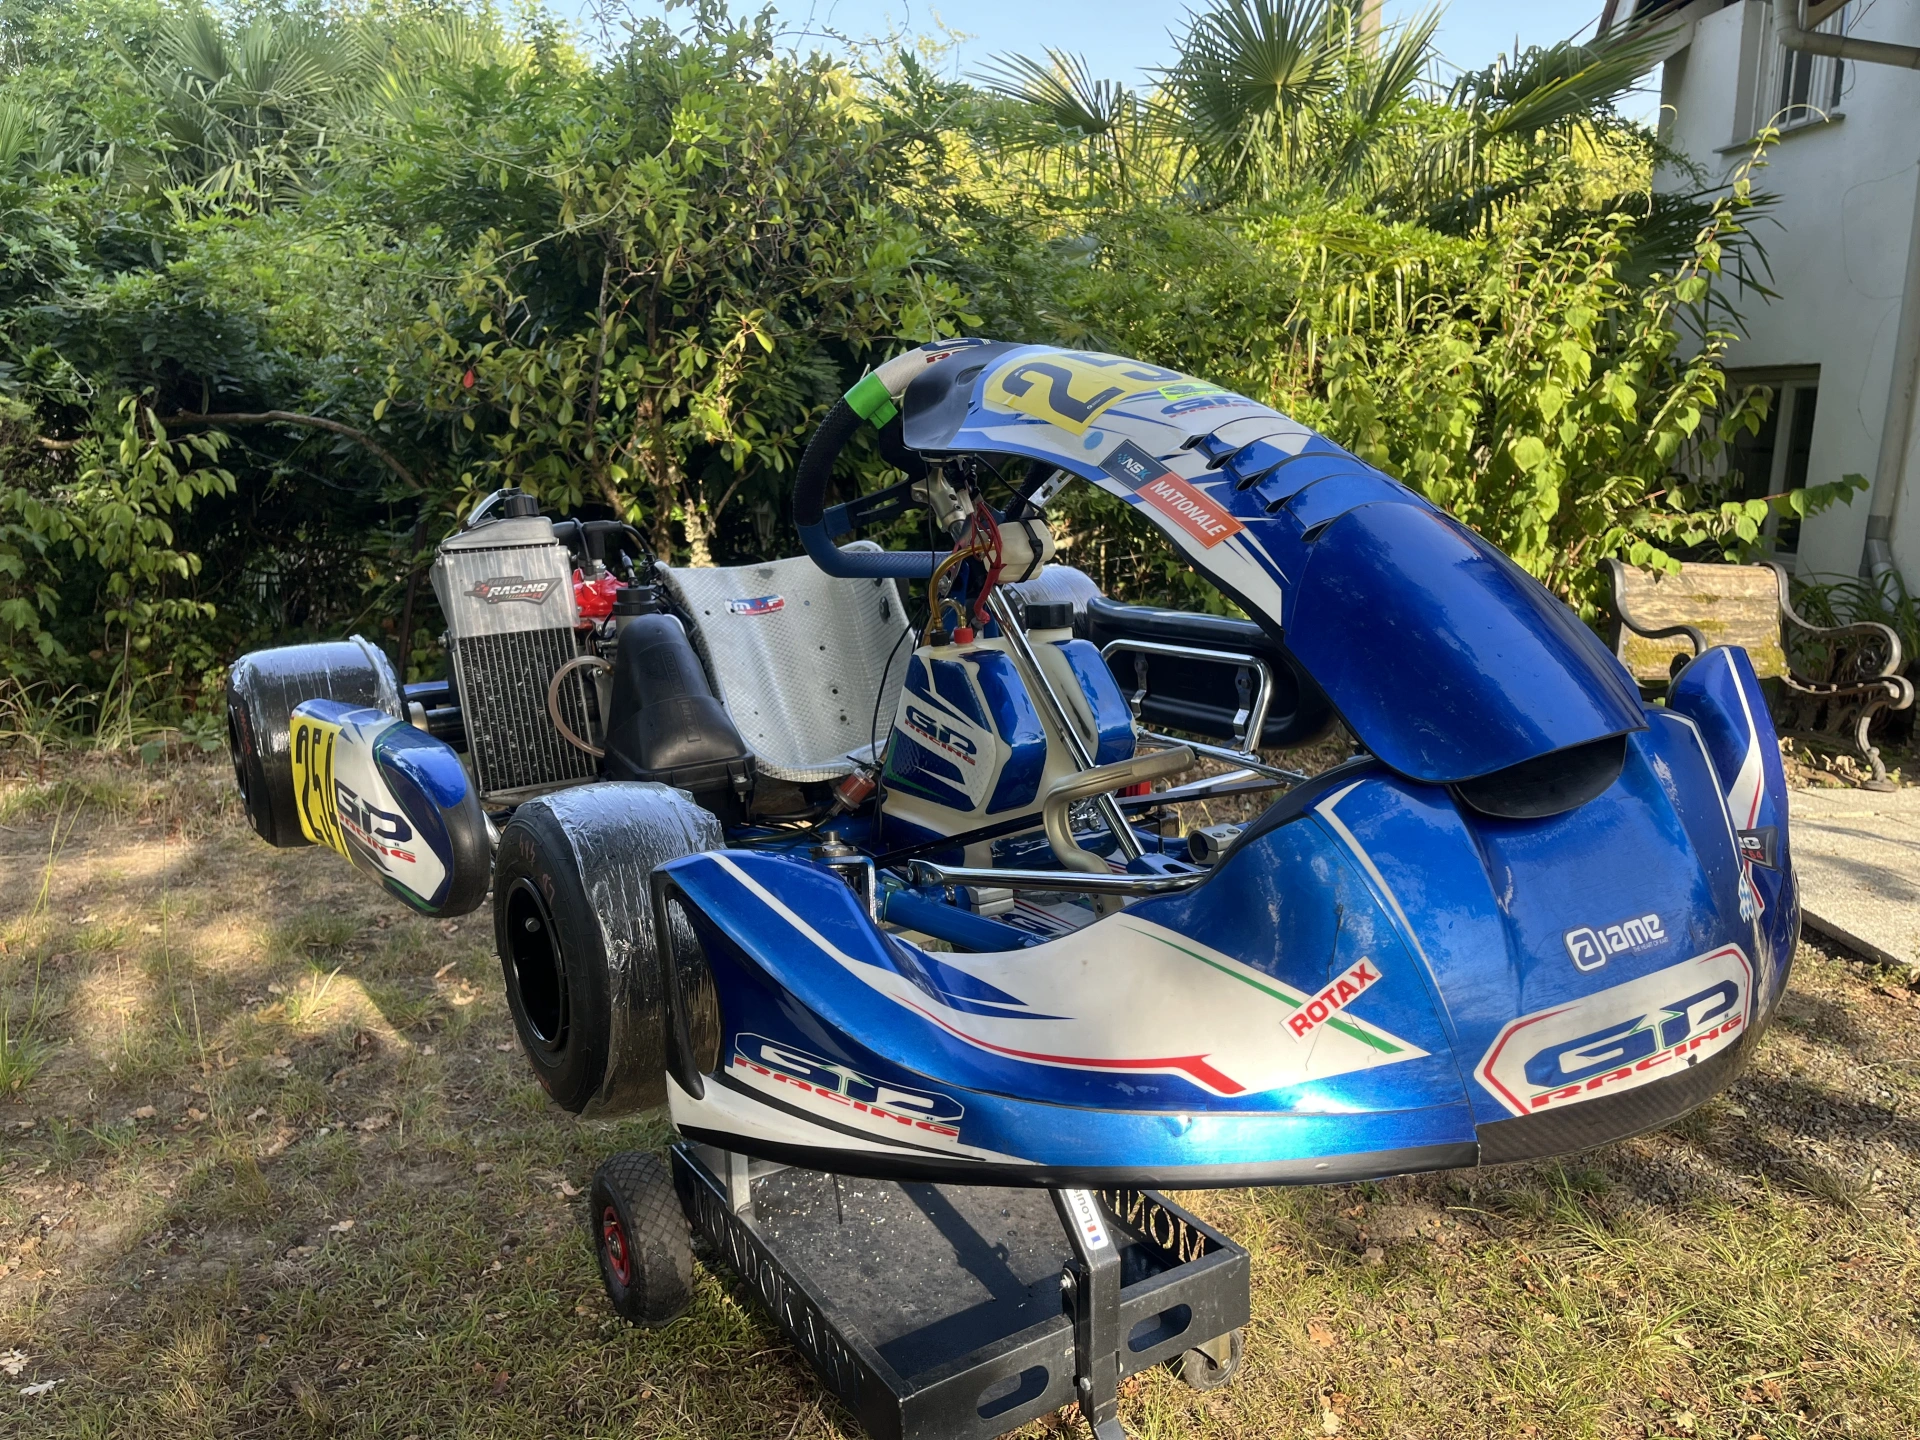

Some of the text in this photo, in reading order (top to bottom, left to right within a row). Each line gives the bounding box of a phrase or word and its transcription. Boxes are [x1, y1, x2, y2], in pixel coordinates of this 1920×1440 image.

[1002, 353, 1183, 424] 25
[1120, 457, 1152, 480] NSK
[1150, 481, 1228, 536] NATIONALE
[904, 719, 976, 766] RACING
[906, 705, 977, 755] GP
[295, 724, 350, 860] 254
[334, 778, 413, 843] GP
[1288, 963, 1376, 1037] ROTAX
[1523, 979, 1739, 1088] GP
[734, 1056, 959, 1137] RACING
[1530, 1014, 1742, 1109] RACING
